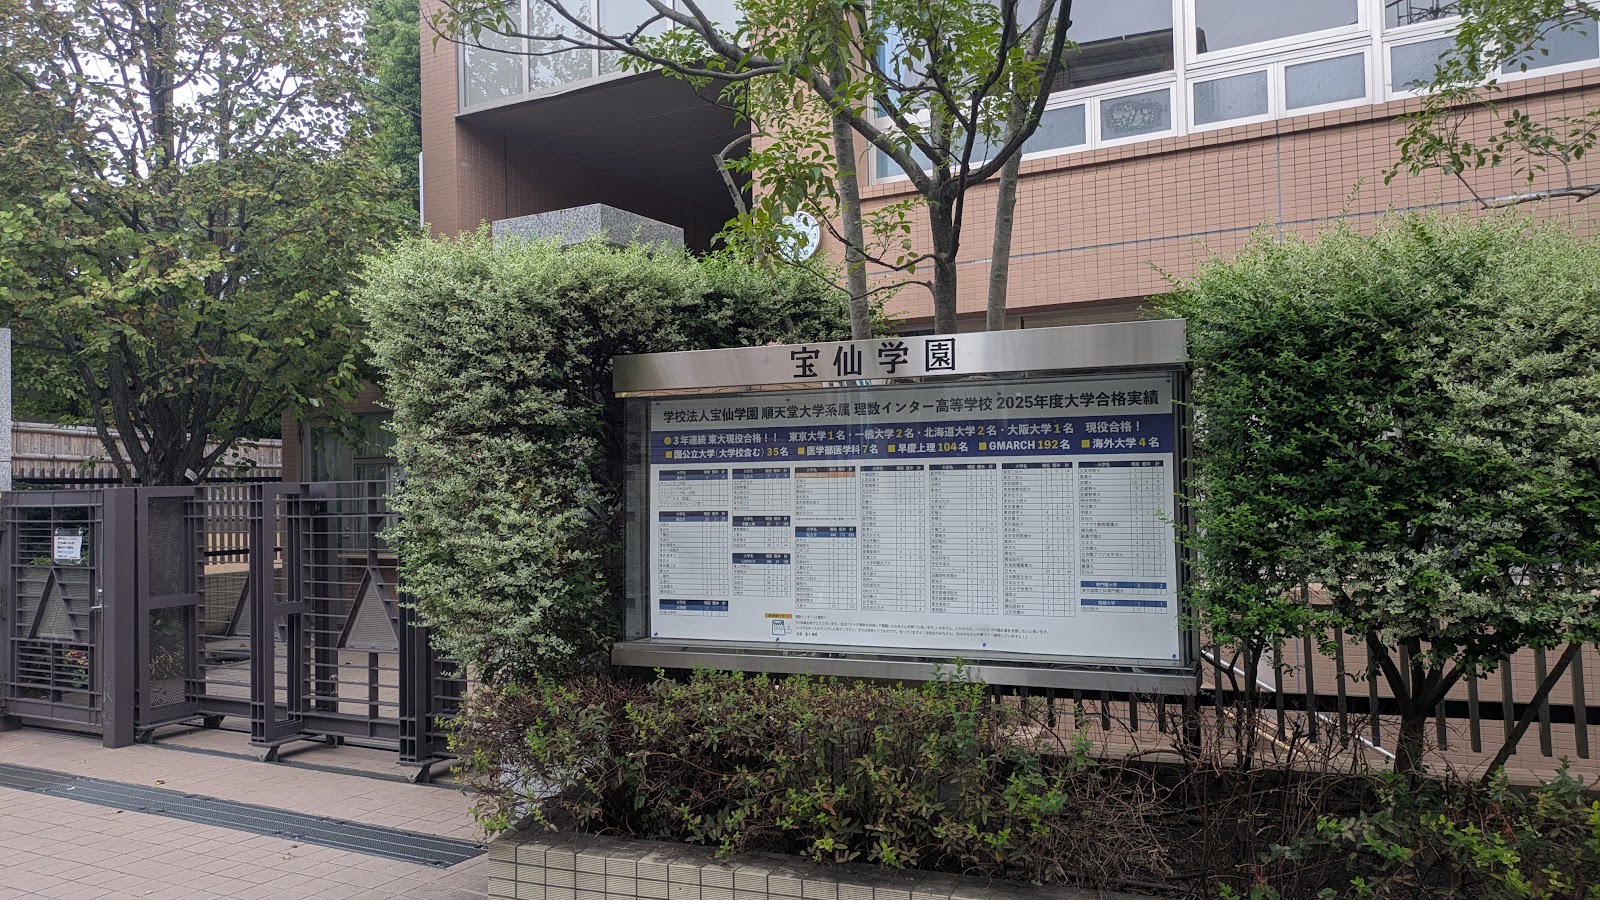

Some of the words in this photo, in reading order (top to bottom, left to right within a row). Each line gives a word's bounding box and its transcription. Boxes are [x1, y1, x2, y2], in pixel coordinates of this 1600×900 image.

[790, 338, 956, 378] 宝仙学園
[663, 406, 759, 423] 学校法人宝仙学園
[761, 402, 851, 420] 順天堂大学系属
[854, 397, 993, 416] 理数インター高等学校
[996, 390, 1159, 410] 2025年度大学合格実績
[673, 434, 706, 446] 3年連続
[989, 440, 1035, 451] GMARCH
[1037, 439, 1070, 449] 192名
